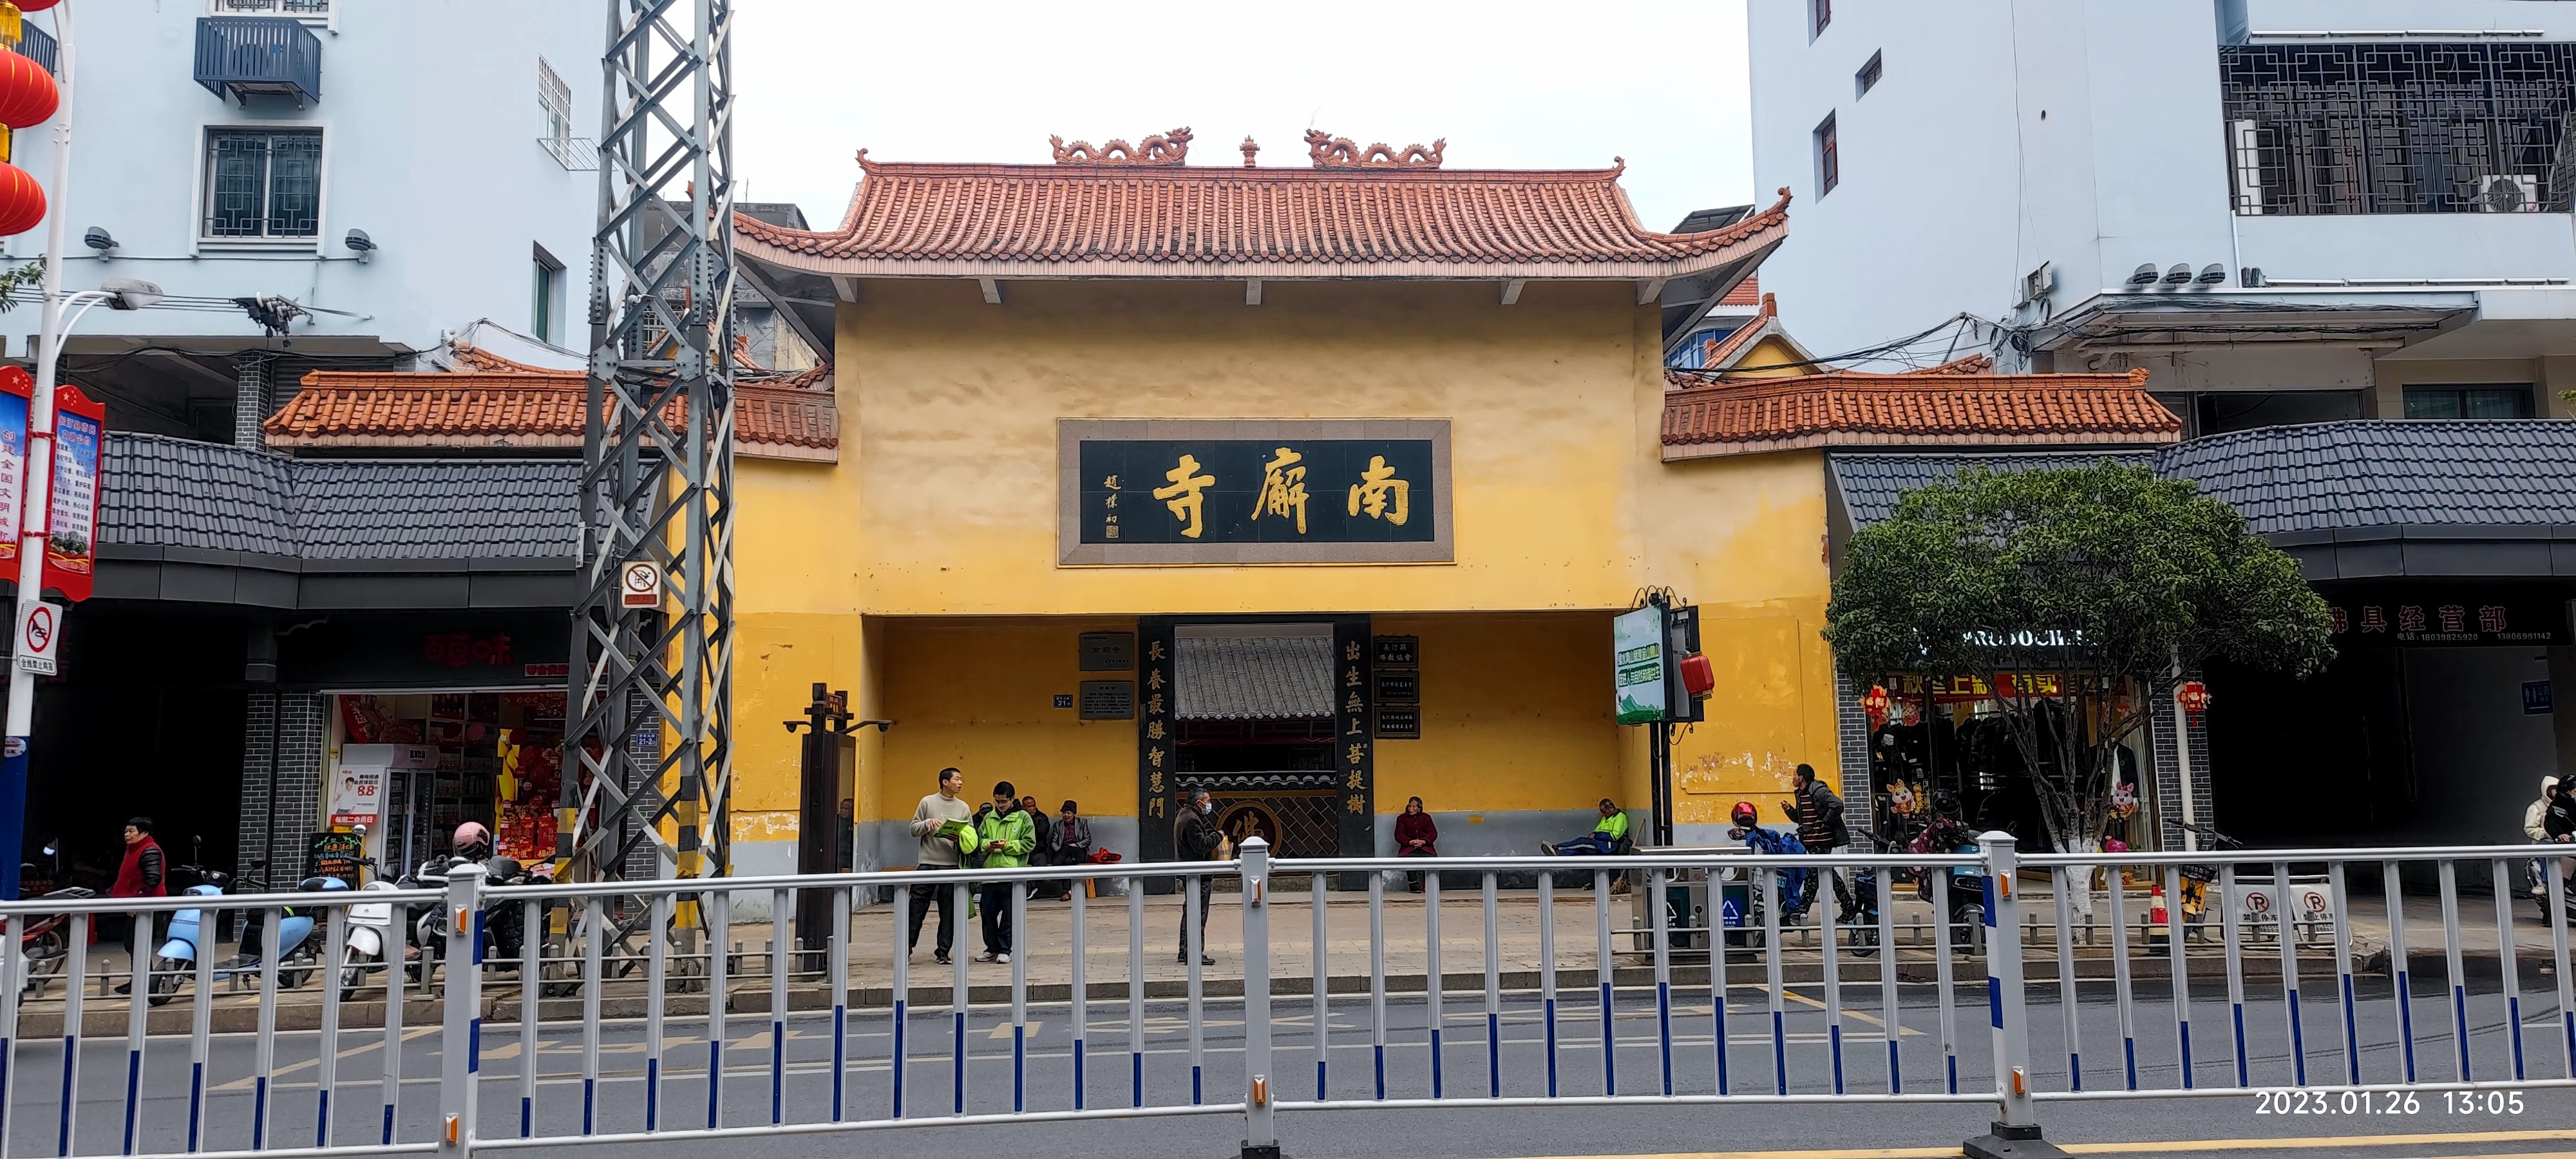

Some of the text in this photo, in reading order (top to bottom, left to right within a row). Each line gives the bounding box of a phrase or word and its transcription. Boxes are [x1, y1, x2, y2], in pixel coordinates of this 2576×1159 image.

[2497, 632, 2552, 640] 13806991142
[2242, 914, 2278, 922] 禁停车
